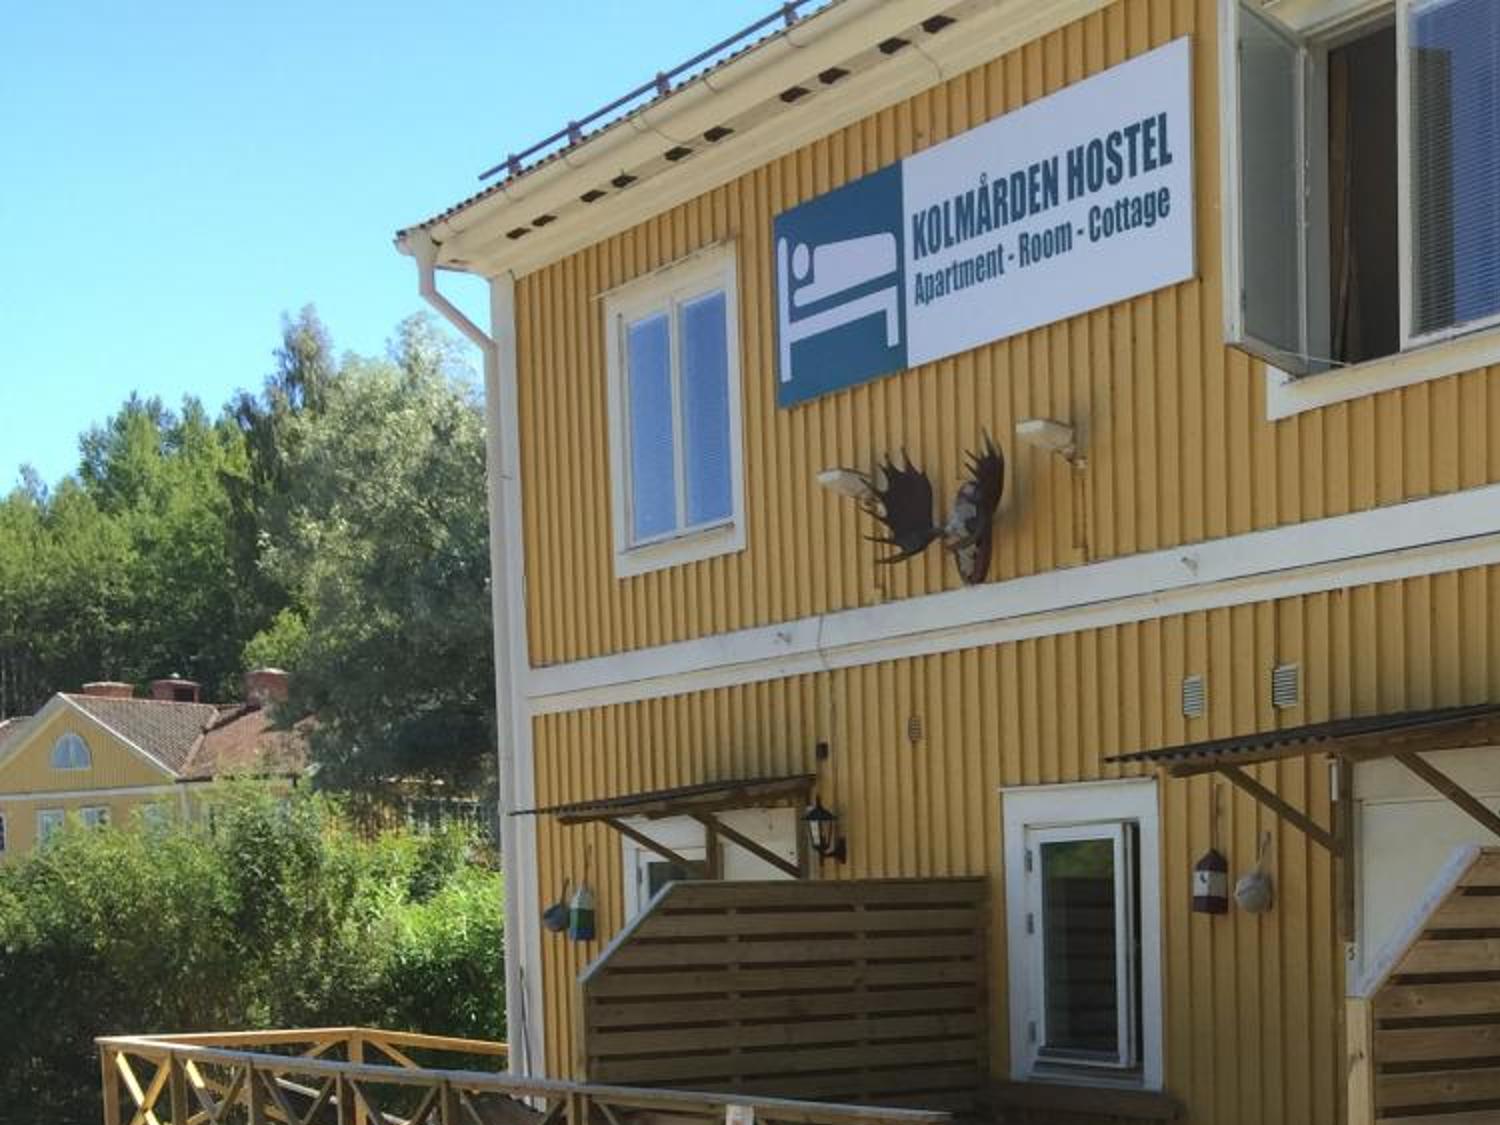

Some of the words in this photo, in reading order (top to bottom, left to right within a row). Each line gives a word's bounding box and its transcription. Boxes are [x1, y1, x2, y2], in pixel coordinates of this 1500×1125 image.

[912, 155, 1059, 260] KOLMÅRDEN
[1066, 112, 1173, 201] HOSTEL
[914, 244, 1005, 306] Apartment
[1019, 221, 1073, 268] Room
[1088, 186, 1171, 242] Cottage
